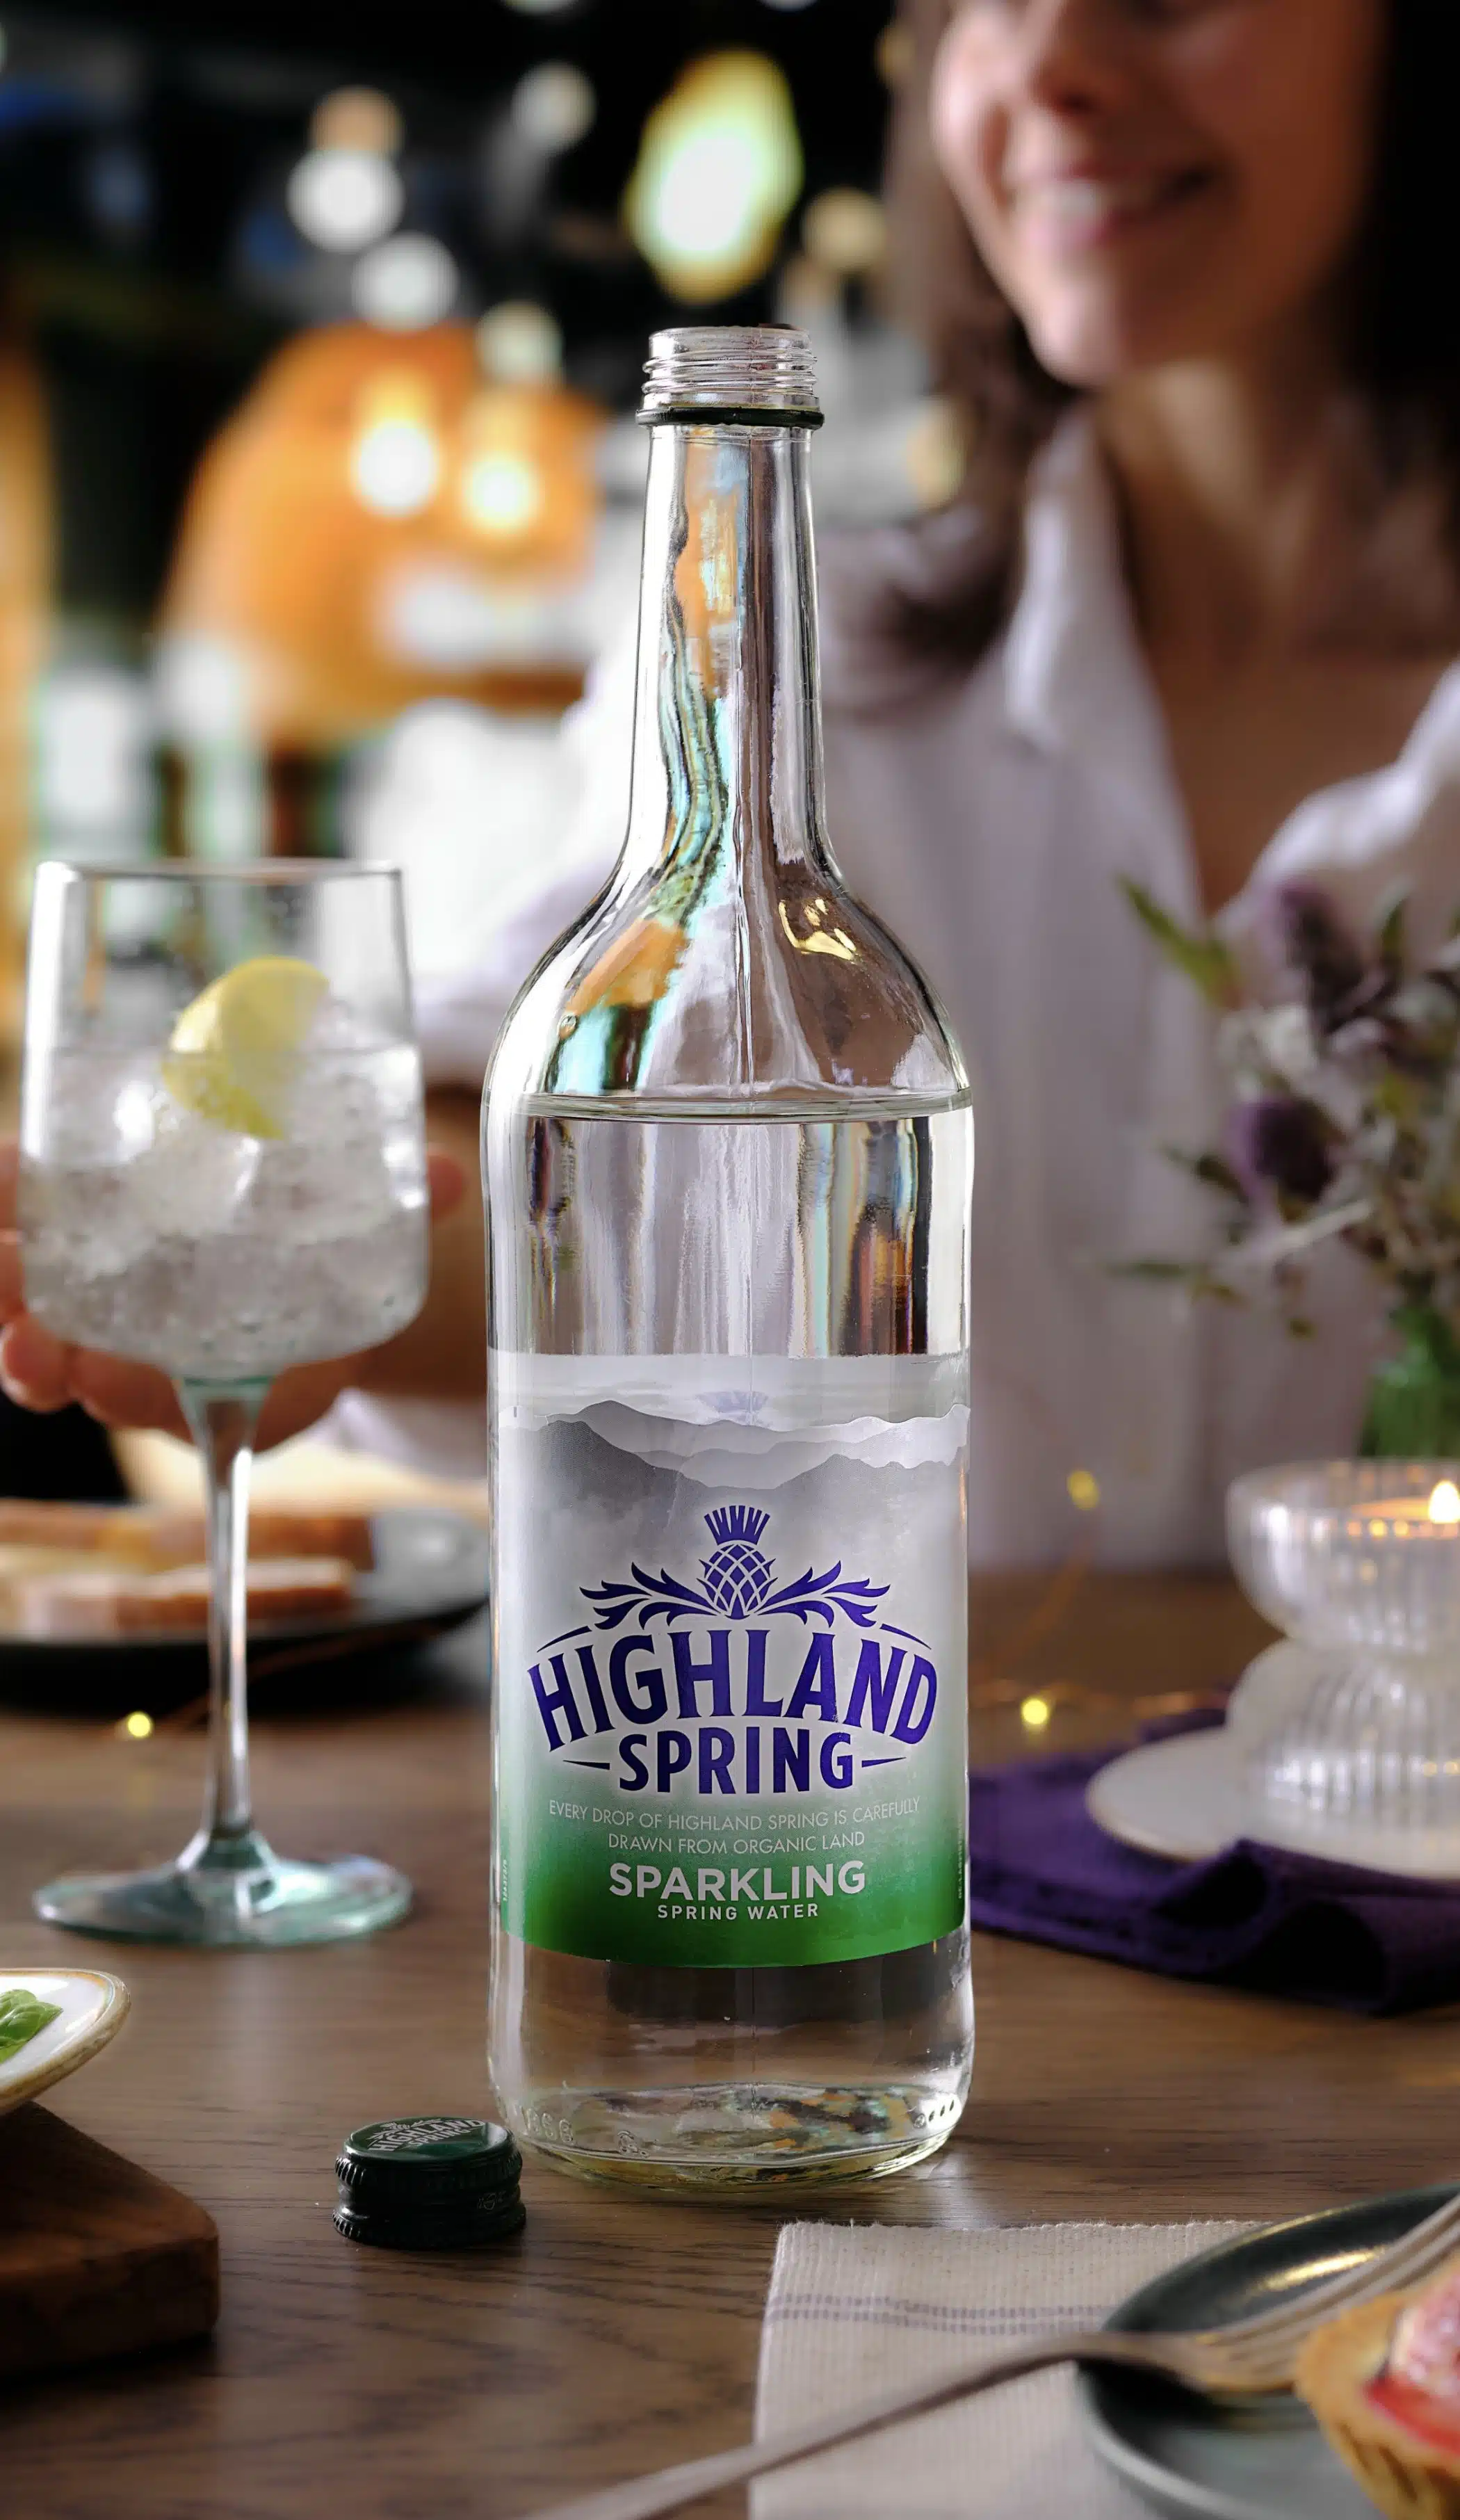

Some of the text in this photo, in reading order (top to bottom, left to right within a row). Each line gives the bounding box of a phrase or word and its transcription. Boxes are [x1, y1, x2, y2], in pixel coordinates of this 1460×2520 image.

[528, 1629, 937, 1752] HIGHLAND
[619, 1727, 853, 1794] SPRING
[549, 1796, 921, 1830] EVERY DROP OF HIGHLAND SPRING IS CAREFULLY
[609, 1831, 865, 1855] DRAWN FROM ORGANIC LAND
[609, 1860, 865, 1902] SPARKLING
[658, 1903, 818, 1920] SPRING WATER
[368, 2119, 486, 2151] HIGHLAND
[409, 2128, 471, 2147] SPRING
